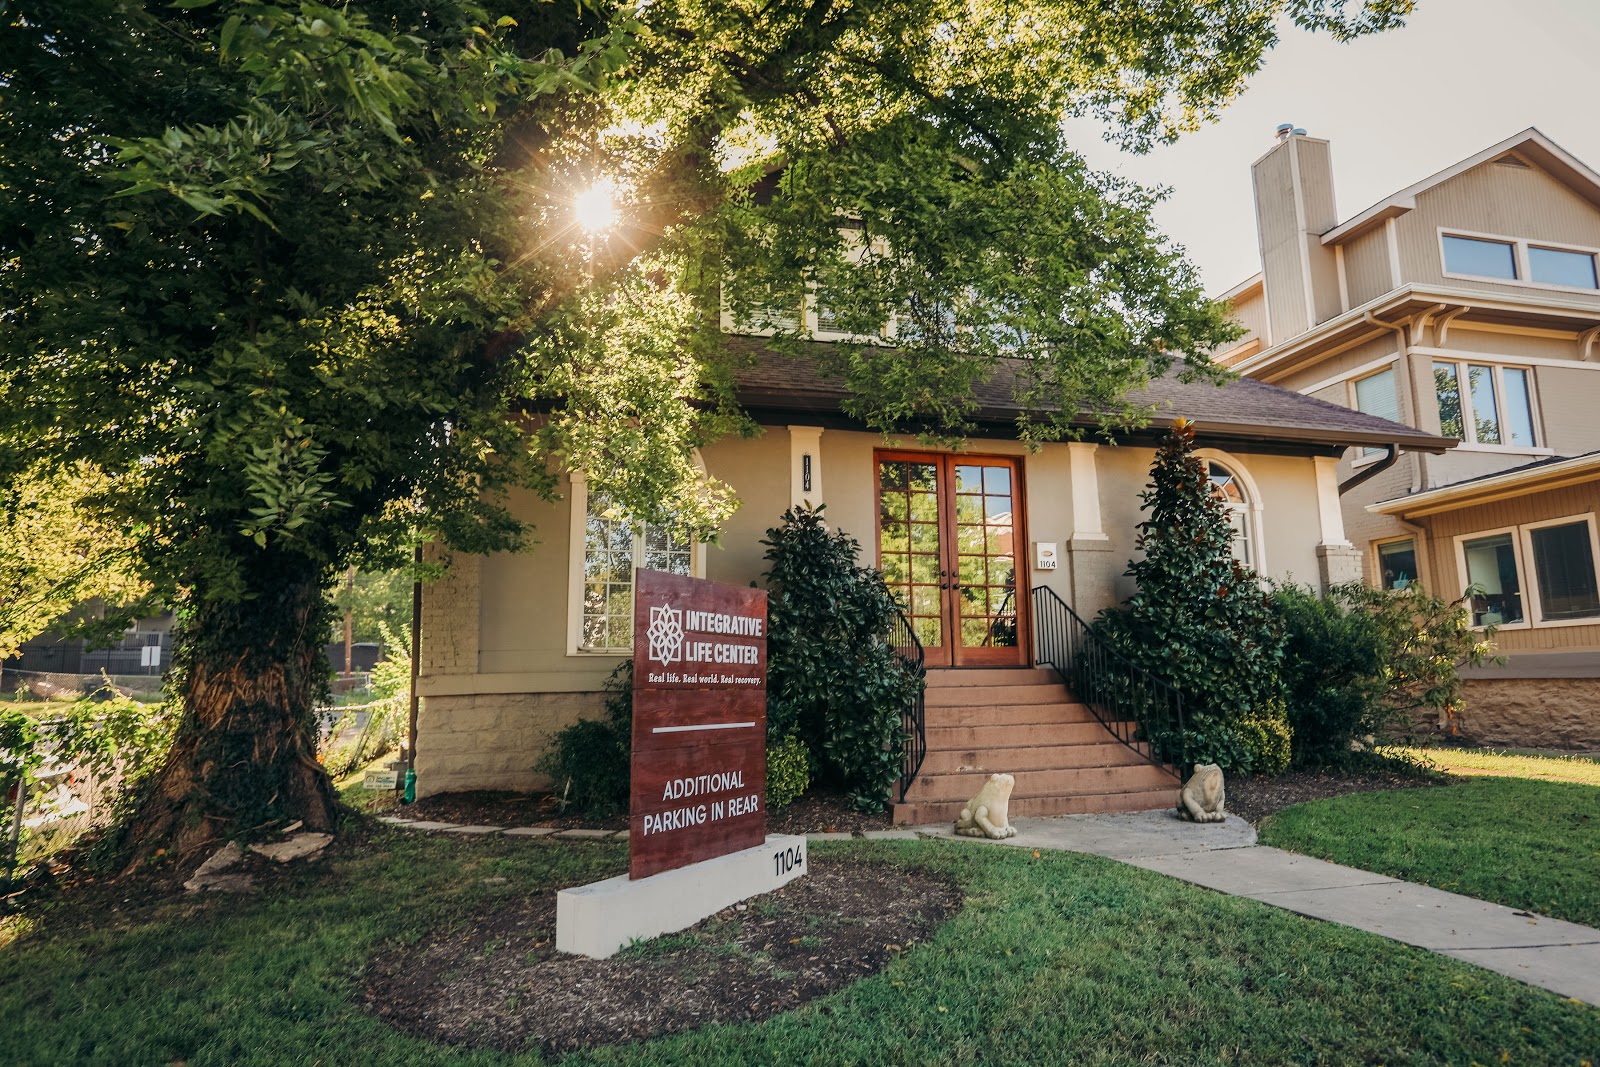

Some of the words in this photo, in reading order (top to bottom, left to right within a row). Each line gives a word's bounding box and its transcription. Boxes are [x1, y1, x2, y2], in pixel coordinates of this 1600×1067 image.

[1040, 560, 1056, 568] 1104
[685, 609, 763, 637] INTEGRATIVE
[685, 641, 713, 663] LIFE
[714, 643, 759, 665] CENTER
[648, 672, 665, 683] Real
[666, 672, 681, 683] life.
[682, 673, 697, 684] Real
[699, 674, 720, 685] world.
[720, 674, 734, 684] Real
[735, 677, 762, 686] recovery.
[662, 770, 745, 802] ADDITIONAL
[643, 804, 707, 837] PARKING
[711, 800, 724, 822] IN
[728, 794, 759, 818] REAR
[773, 844, 803, 877] 1104
